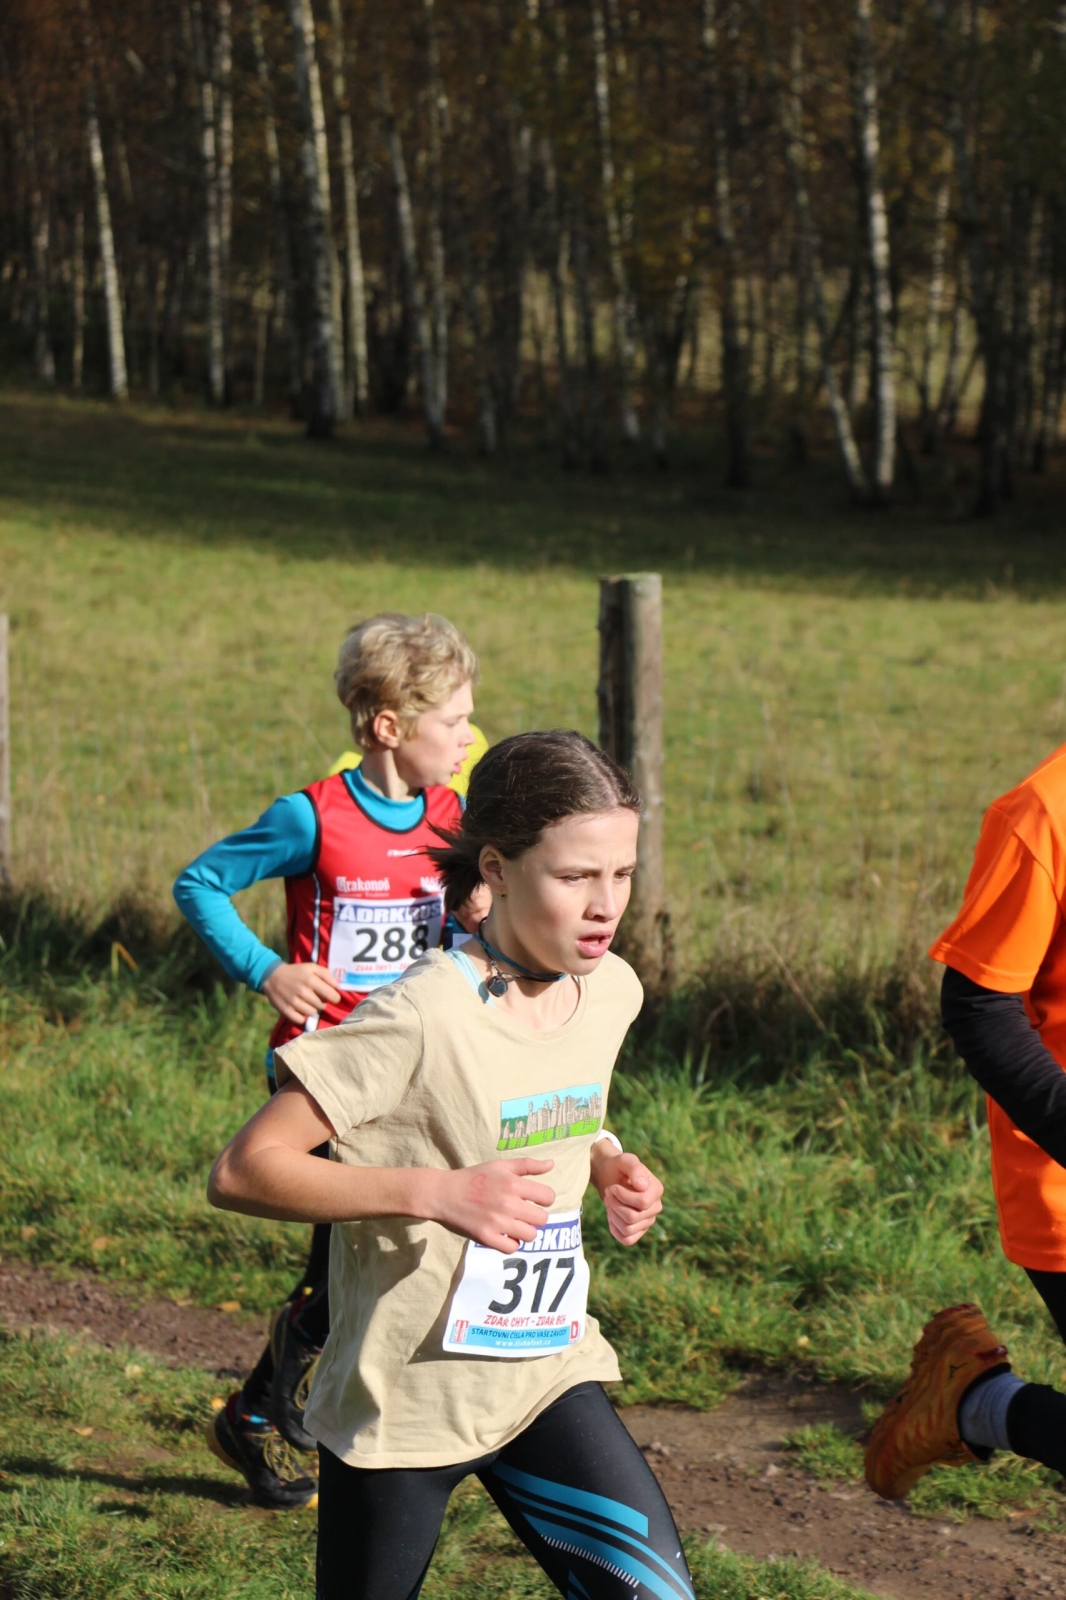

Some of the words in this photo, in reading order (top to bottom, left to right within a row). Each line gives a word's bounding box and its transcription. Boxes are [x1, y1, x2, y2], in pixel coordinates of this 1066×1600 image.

[352, 926, 429, 963] 288
[488, 1256, 575, 1314] 317
[471, 1327, 509, 1339] STARTOVNÍ
[509, 1330, 525, 1339] ČÍSLA
[537, 1330, 550, 1338] VAŠE
[484, 1314, 509, 1327] ZDAŘ
[511, 1316, 530, 1327] CHYT
[535, 1315, 555, 1326] ZDAŘ
